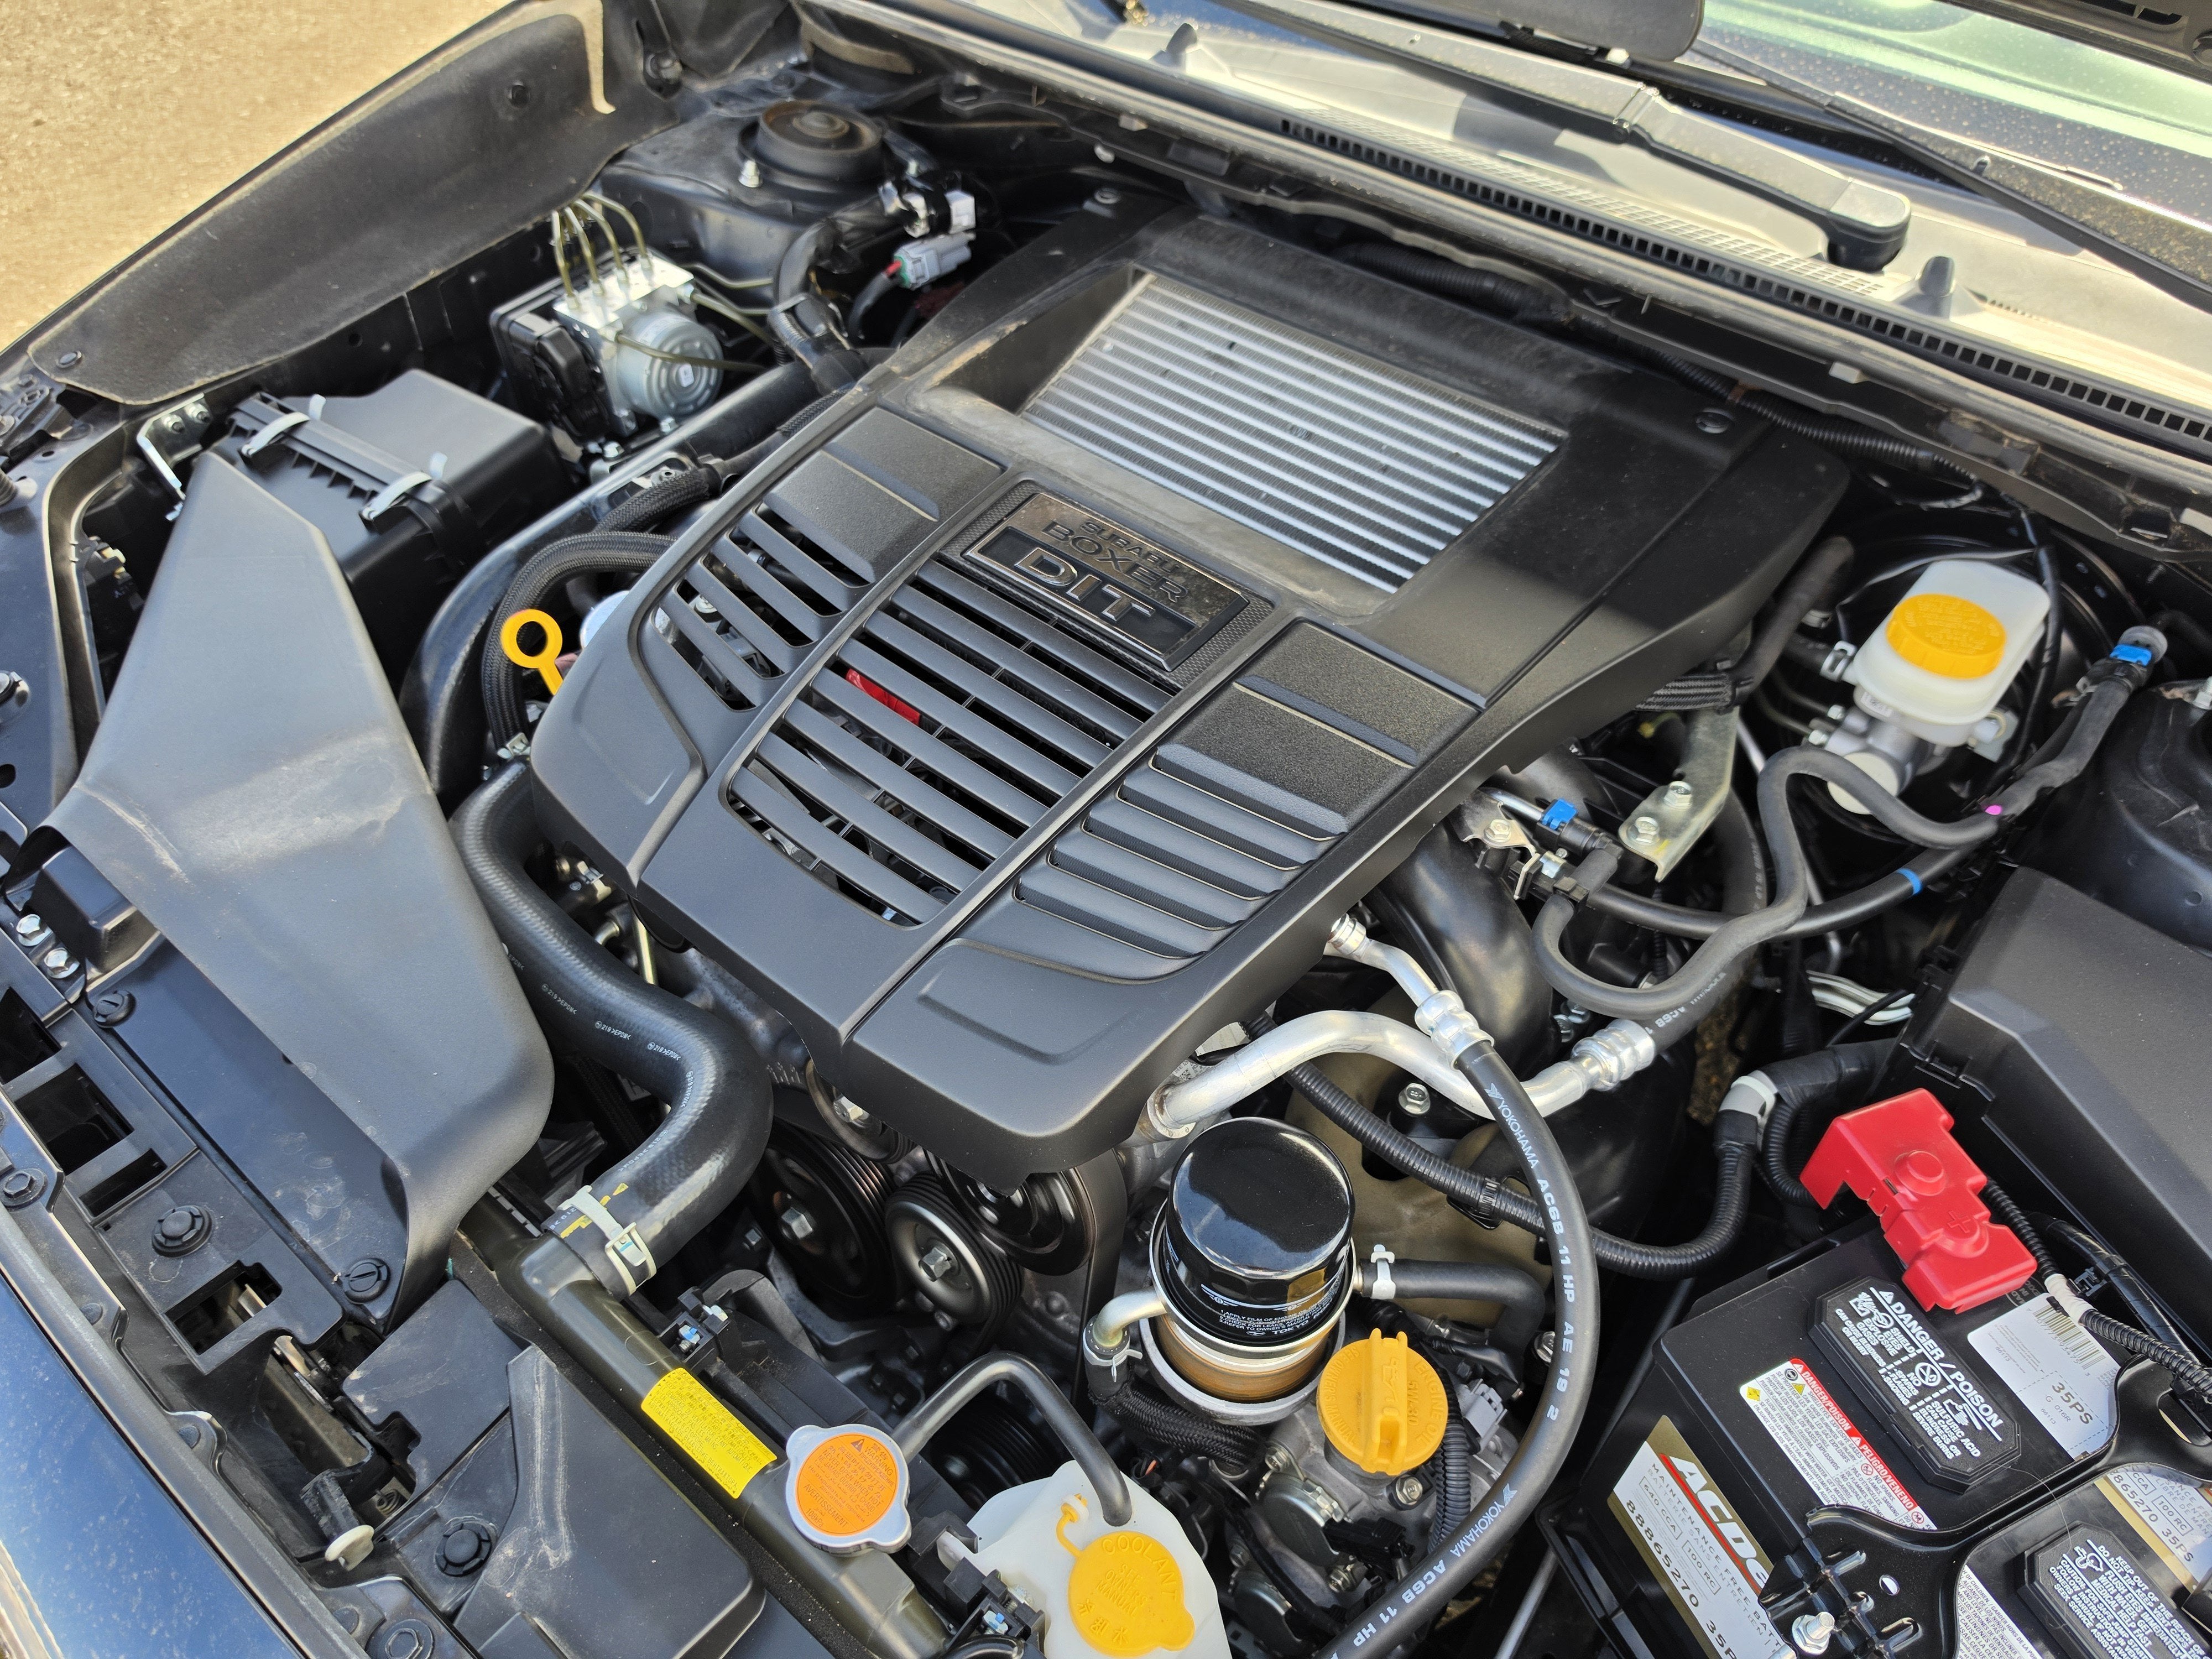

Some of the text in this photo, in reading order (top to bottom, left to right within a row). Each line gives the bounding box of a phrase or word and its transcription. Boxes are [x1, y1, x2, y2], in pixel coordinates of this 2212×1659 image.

[1041, 521, 1190, 604] BOXER
[1080, 520, 1182, 573] SUBARU
[1014, 547, 1156, 623] DIT
[1496, 1098, 1576, 1419] YOKOHAMA AC6B 11 HP AE 19 2
[1271, 1319, 1310, 1335] TOKYO
[1835, 1308, 1886, 1367] CAN CAUSE BLINDNESS
[1841, 1327, 1869, 1355] OR INJURY
[1856, 1322, 1879, 1346] GASES
[1863, 1318, 1898, 1356] EXPLOSIVE
[1883, 1331, 1903, 1351] EYES
[1890, 1327, 1915, 1355] SHIELD
[1891, 1302, 2002, 1427] DANGER POISON
[1906, 1372, 1922, 1386] NO
[1406, 1378, 1421, 1427] 5W-30
[1413, 1359, 1445, 1447] ENGINE OIL
[1802, 1371, 1850, 1430] DANGER/POISON
[1809, 1404, 1822, 1418] CAUSE
[2052, 1382, 2093, 1425] 35PS
[2054, 1405, 2072, 1422] 016R
[1324, 1404, 1357, 1446] MANUAL
[1764, 1398, 1807, 1451] FLUSH EYES IMMEDIATELY
[1829, 1419, 1863, 1459] EXPLOSIVE GASES
[1912, 1411, 1954, 1459] SEVERE BURNS
[1919, 1408, 1961, 1457] BLINDNESS OR
[1925, 1405, 1958, 1442] CAN CAUSE
[1931, 1401, 1981, 1457] SULFURIC ACID
[864, 1446, 894, 1476] WARNING
[1815, 1442, 1840, 1470] EXPLOSIVOS
[1829, 1438, 1850, 1463] EXPLOSIFS
[822, 1449, 882, 1508] NEVER OPEN WHEN HOT
[1820, 1491, 1831, 1504] AGUA
[1834, 1477, 1853, 1499] CIGARROS
[1858, 1477, 1867, 1487] PAS
[1860, 1445, 1913, 1509] PELIGRO/VENENO
[1873, 1474, 1882, 1484] NO
[2132, 1472, 2150, 1491] CCA
[2164, 1479, 2187, 1502] SANS
[804, 1484, 847, 1527] AVERTISSEMENT
[806, 1508, 824, 1527] 108kPa
[1644, 1484, 1676, 1532] 640 CCA
[1669, 1455, 1769, 1588] ACDe
[1881, 1496, 1900, 1517] SMOKING
[2157, 1500, 2188, 1532] 100 RC
[2178, 1503, 2192, 1516] DE
[1652, 1464, 1782, 1647] MAINTENANCE FREE BATT
[2161, 1527, 2194, 1563] 35PS
[1102, 1534, 1178, 1603] COOLANT
[1118, 1562, 1144, 1584] SEE
[1352, 1503, 1507, 1648] YOKOHAMA AC6B 11 HP
[1626, 1500, 1699, 1607] 88865270
[1706, 1620, 1737, 1659] 35P
[1688, 1547, 1716, 1588] 100 RC
[1688, 1528, 1711, 1561] SANS
[1713, 1565, 1763, 1635] ENTRETIEN
[1095, 1579, 1138, 1618] MANUAL
[2054, 1583, 2094, 1629] SEEK SERVICE
[2056, 1565, 2119, 1637] FOLLOW INSTRUCTIONS
[2091, 1579, 2152, 1647] MEDICAL HELP FAST
[2098, 1545, 2189, 1650] DO NOT KEEP VENT CAPS
[2098, 1574, 2116, 1594] WITH
[2137, 1619, 2153, 1635] GET
[2104, 1570, 2144, 1613] FLUSH EYES
[2115, 1556, 2194, 1645] KEEP OUT OF THE REACH
[2084, 1588, 2099, 1604] FOR
[2096, 1603, 2114, 1621] SAFE
[2111, 1621, 2130, 1639] JUMP
